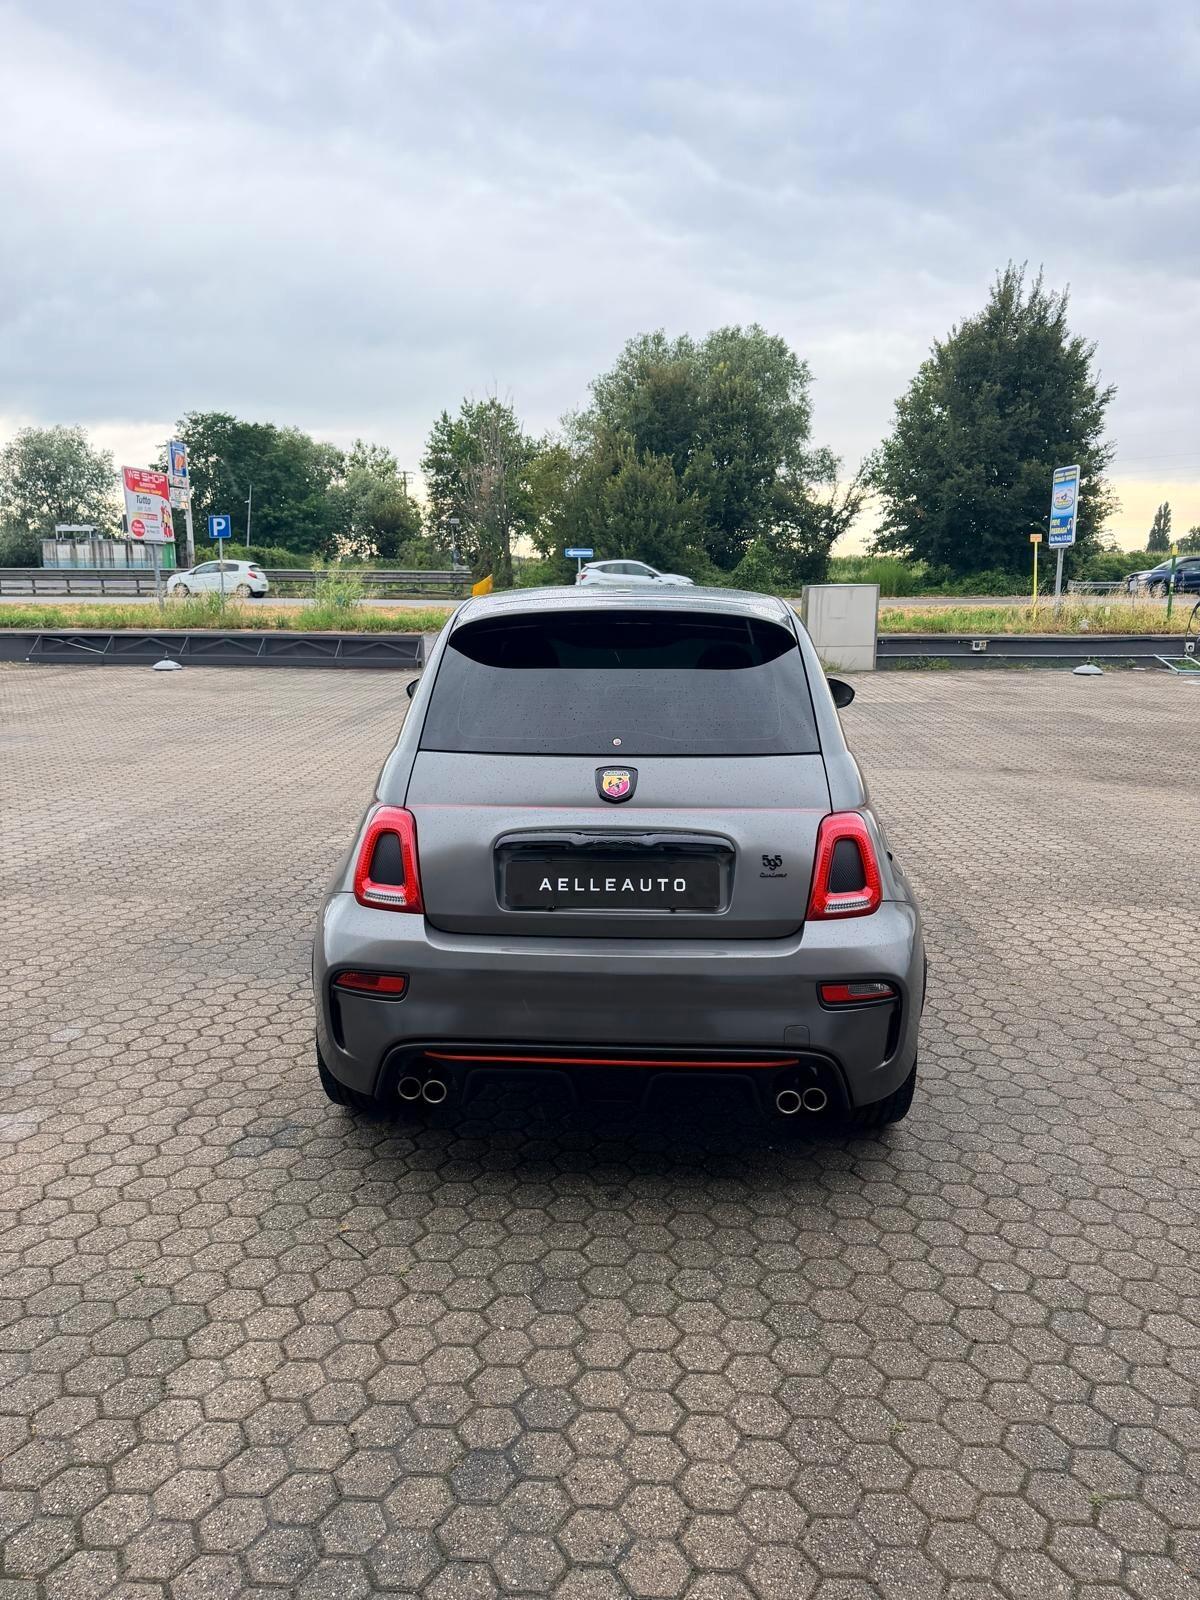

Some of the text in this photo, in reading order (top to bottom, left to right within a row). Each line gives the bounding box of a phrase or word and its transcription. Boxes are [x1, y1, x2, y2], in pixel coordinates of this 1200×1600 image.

[141, 472, 165, 484] SHOP
[213, 518, 226, 536] P
[762, 854, 782, 871] 595
[539, 878, 687, 892] AELLEAUTO
